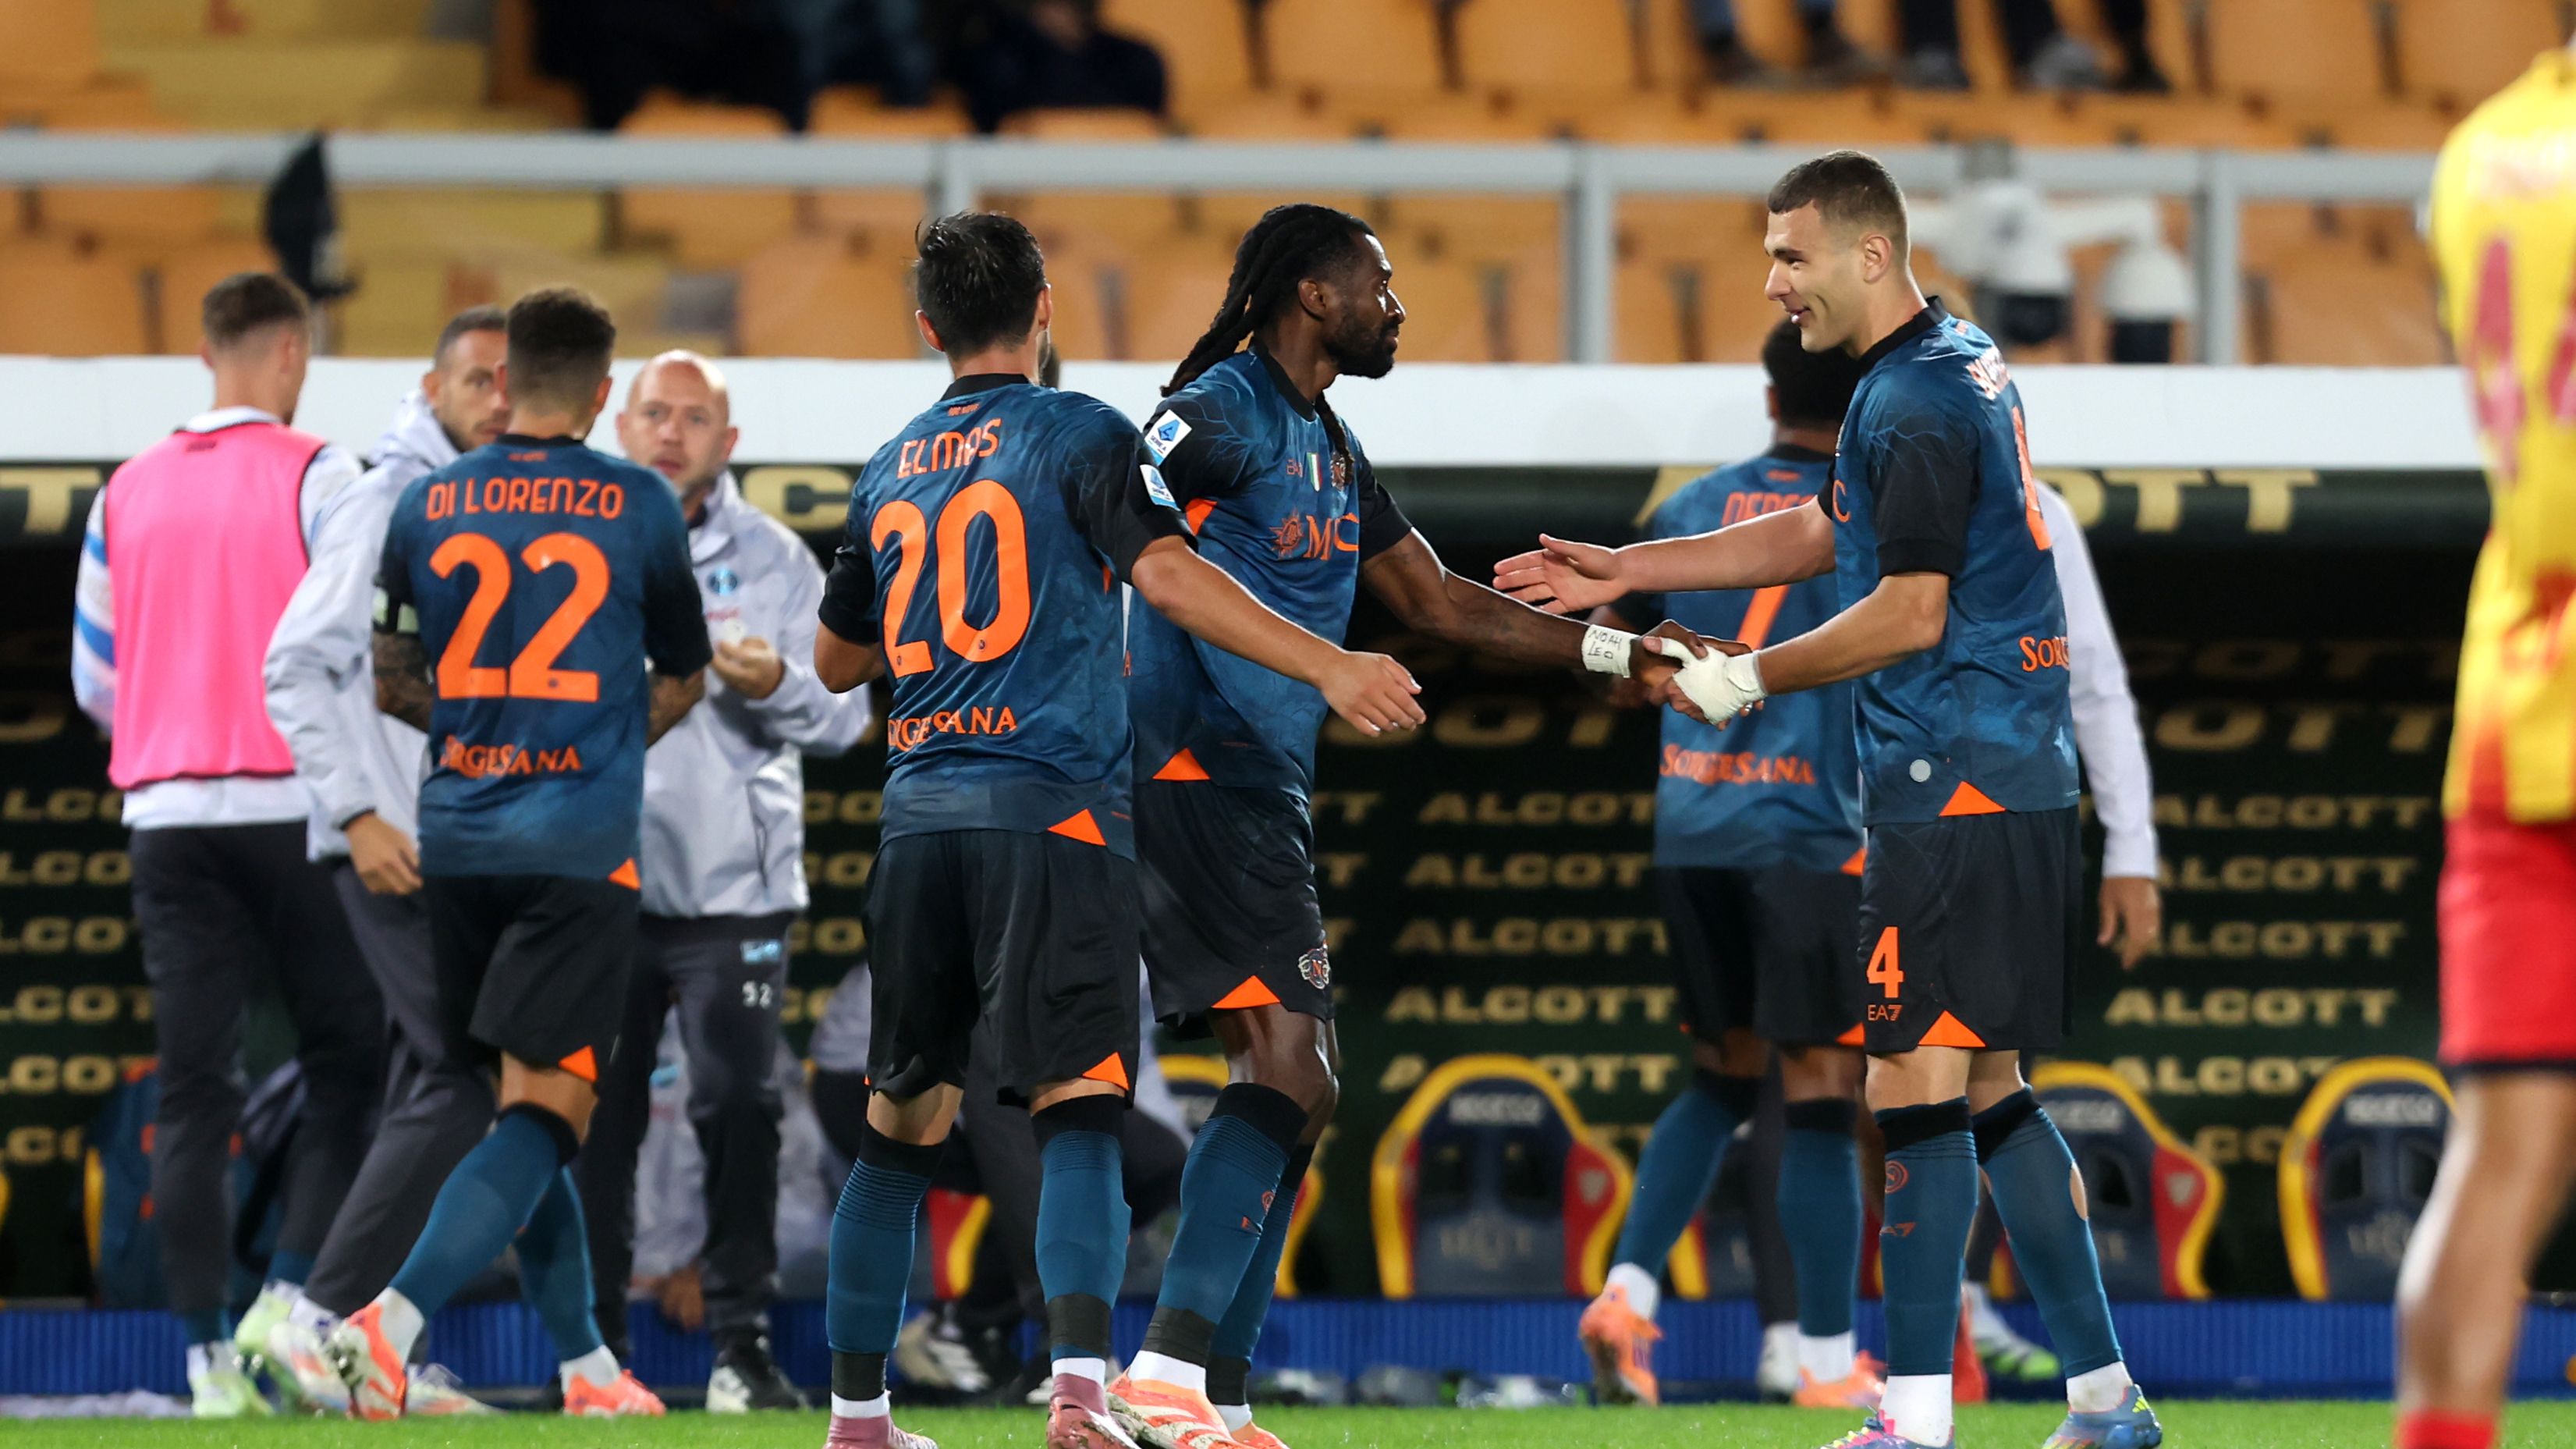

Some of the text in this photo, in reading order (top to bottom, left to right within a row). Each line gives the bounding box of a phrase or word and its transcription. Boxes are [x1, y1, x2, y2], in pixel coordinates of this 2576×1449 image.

[897, 417, 1002, 479] ELMAS
[426, 477, 624, 521] DI LORENZO
[871, 479, 1032, 679] 20
[429, 531, 611, 702] 22
[1588, 629, 1623, 651] NOAH
[1588, 641, 1614, 660] LEO
[1418, 792, 1657, 824] ALCOT
[1404, 853, 1654, 888] ALCOT
[1866, 926, 1904, 999] 4
[1384, 986, 1679, 1024] ALCOTT
[1867, 1003, 1903, 1021] EA7
[2104, 988, 2398, 1027] ALCOTT
